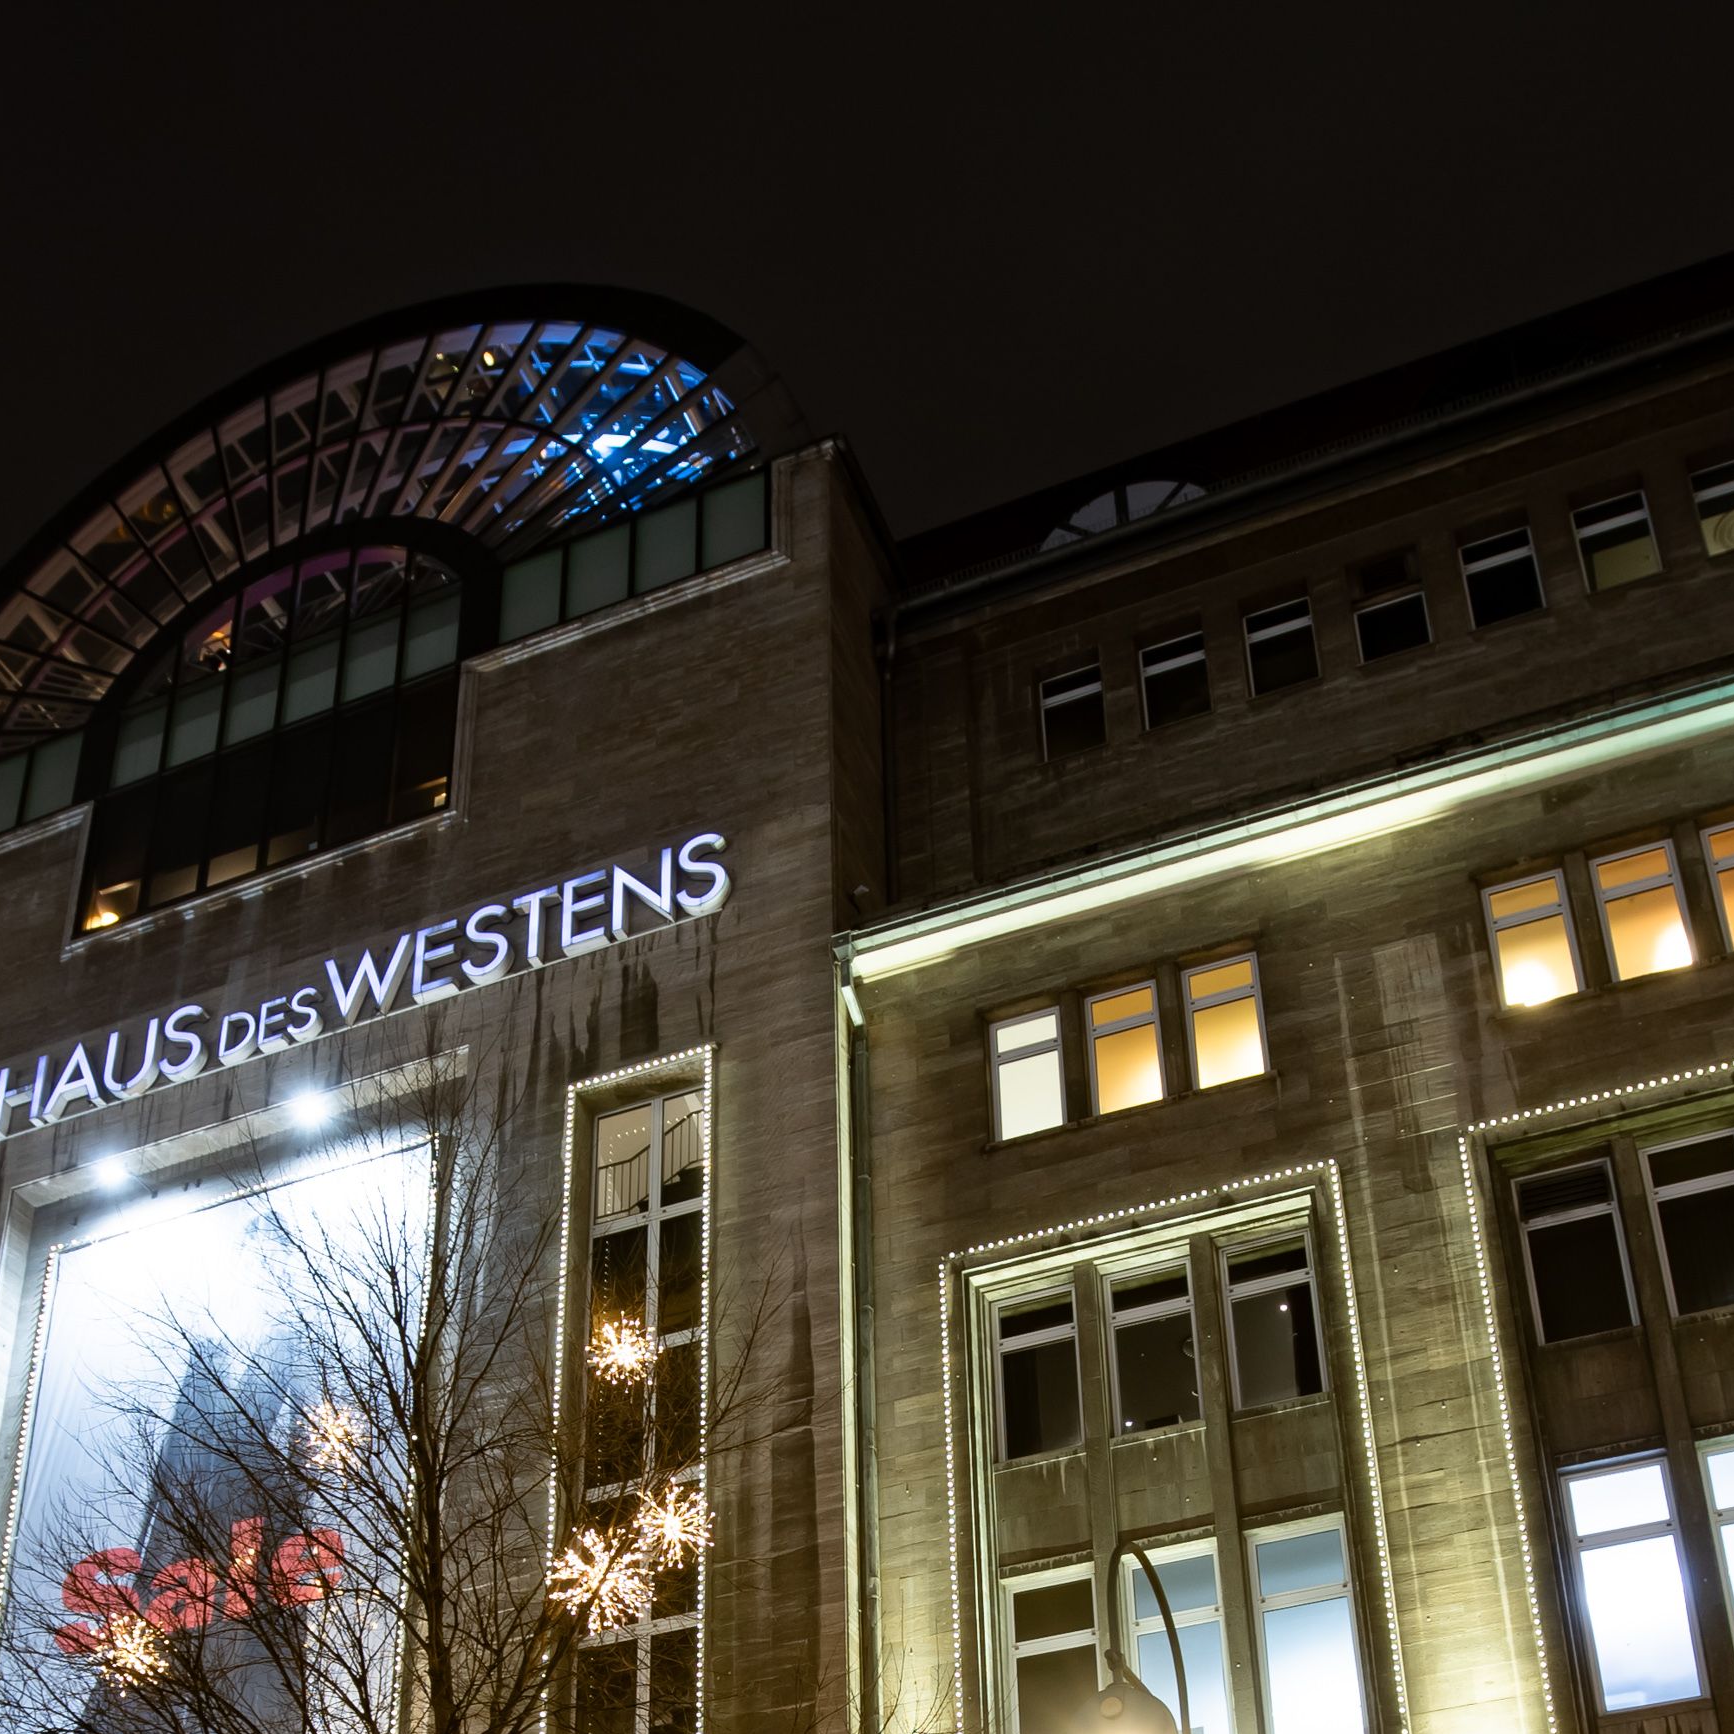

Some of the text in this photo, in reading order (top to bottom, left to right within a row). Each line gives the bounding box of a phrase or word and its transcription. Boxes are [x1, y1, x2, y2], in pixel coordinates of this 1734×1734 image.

[217, 987, 325, 1065] DES
[324, 832, 732, 1026] WESTENS
[54, 1515, 344, 1654] Sale
